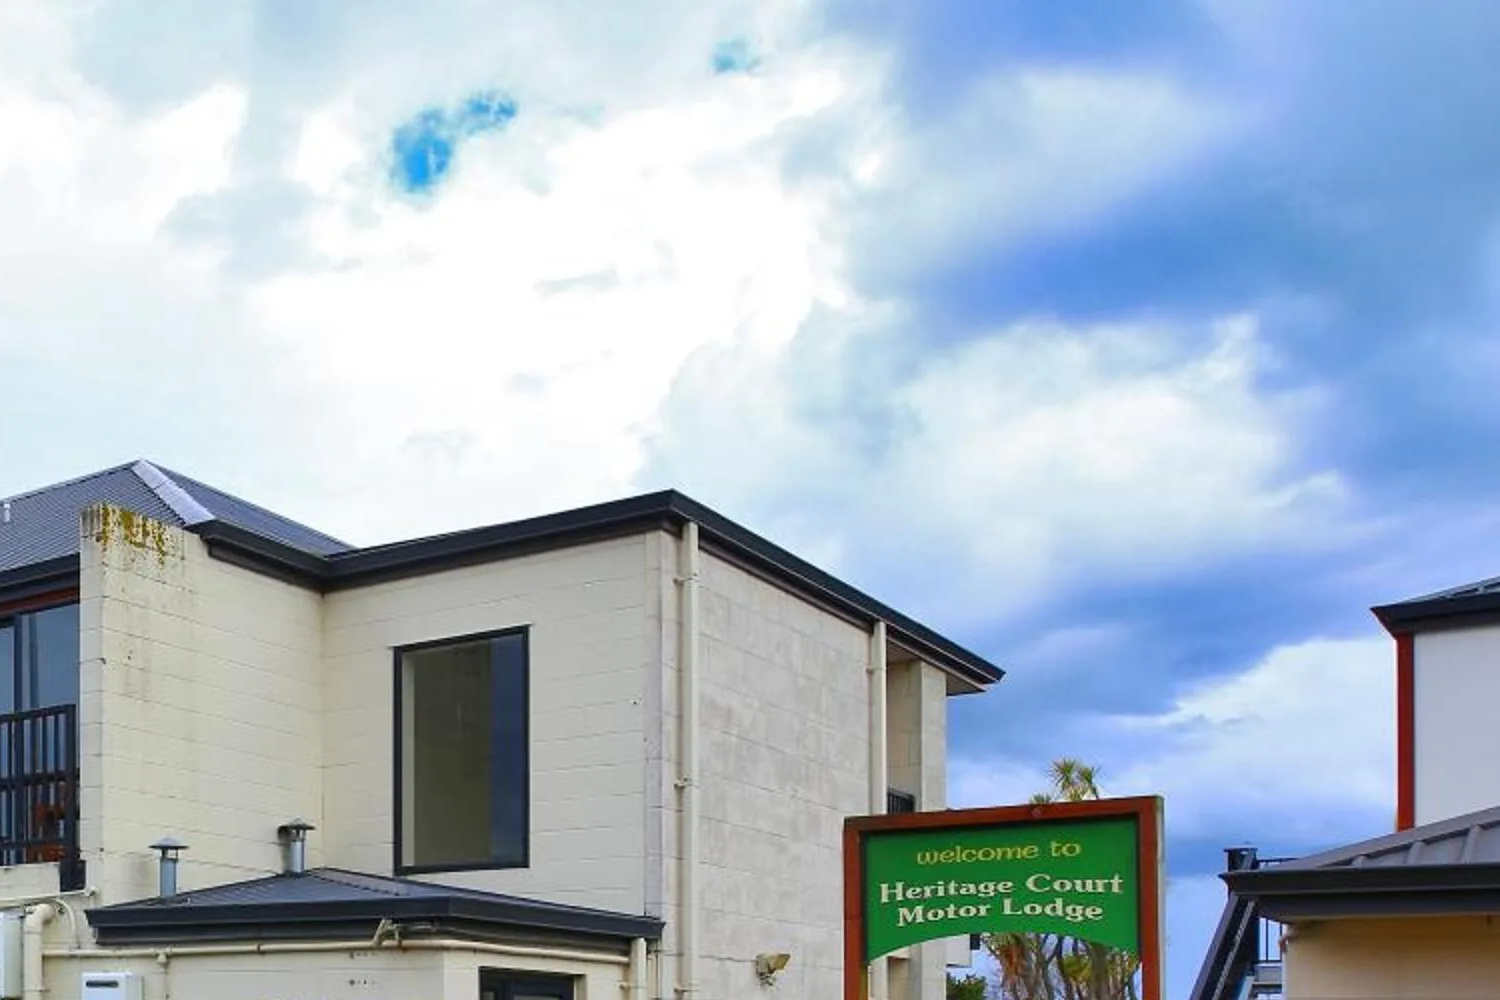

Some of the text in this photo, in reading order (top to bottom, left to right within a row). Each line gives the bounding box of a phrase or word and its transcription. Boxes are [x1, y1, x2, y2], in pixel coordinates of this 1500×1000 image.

[916, 840, 1082, 866] welcome to
[879, 872, 1124, 904] Heritage Court
[896, 896, 1104, 927] Motor Lodge
